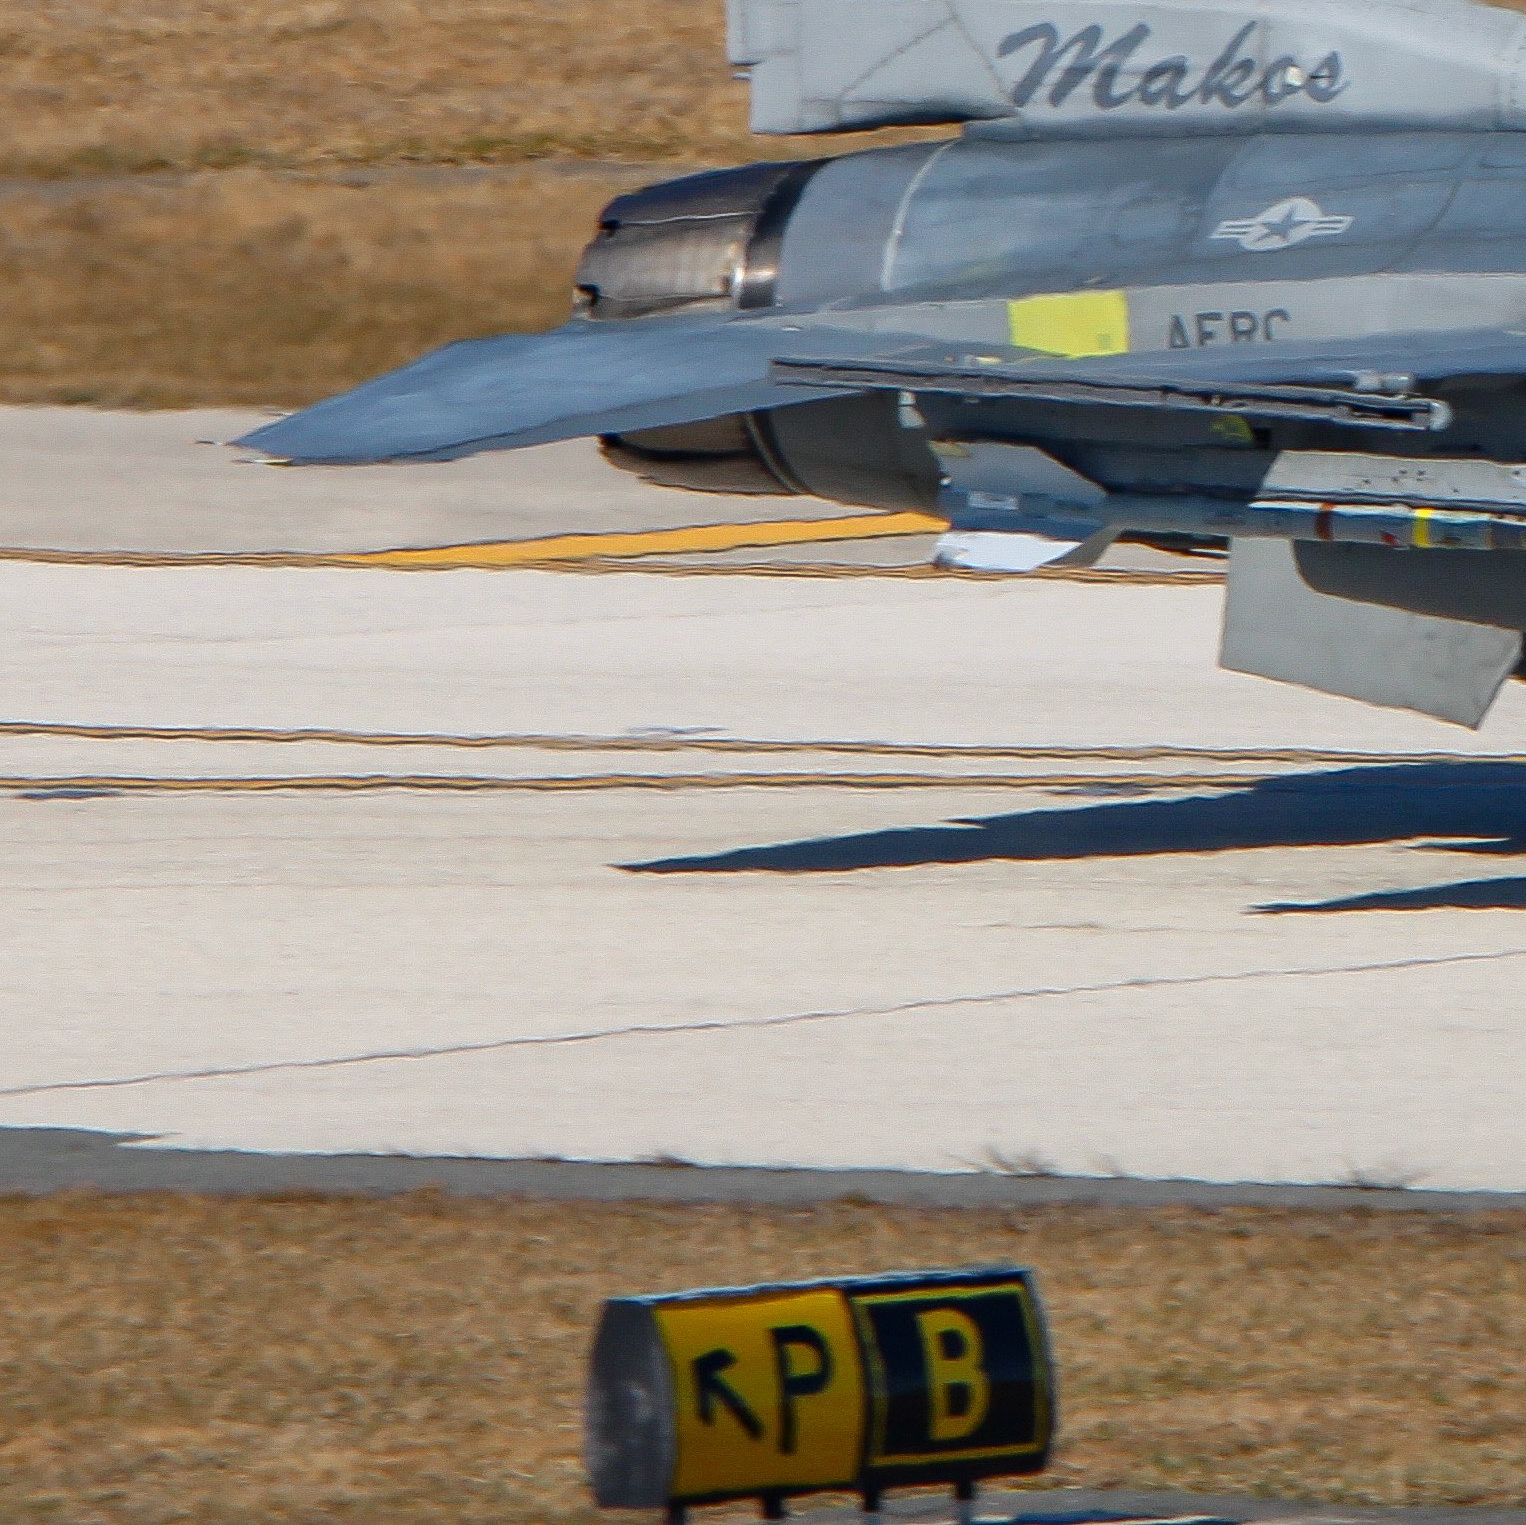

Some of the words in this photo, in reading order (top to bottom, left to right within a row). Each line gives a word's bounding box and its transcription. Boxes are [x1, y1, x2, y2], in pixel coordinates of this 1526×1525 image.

[997, 21, 1348, 108] Makos
[768, 1323, 836, 1457] P
[914, 1307, 992, 1442] B
